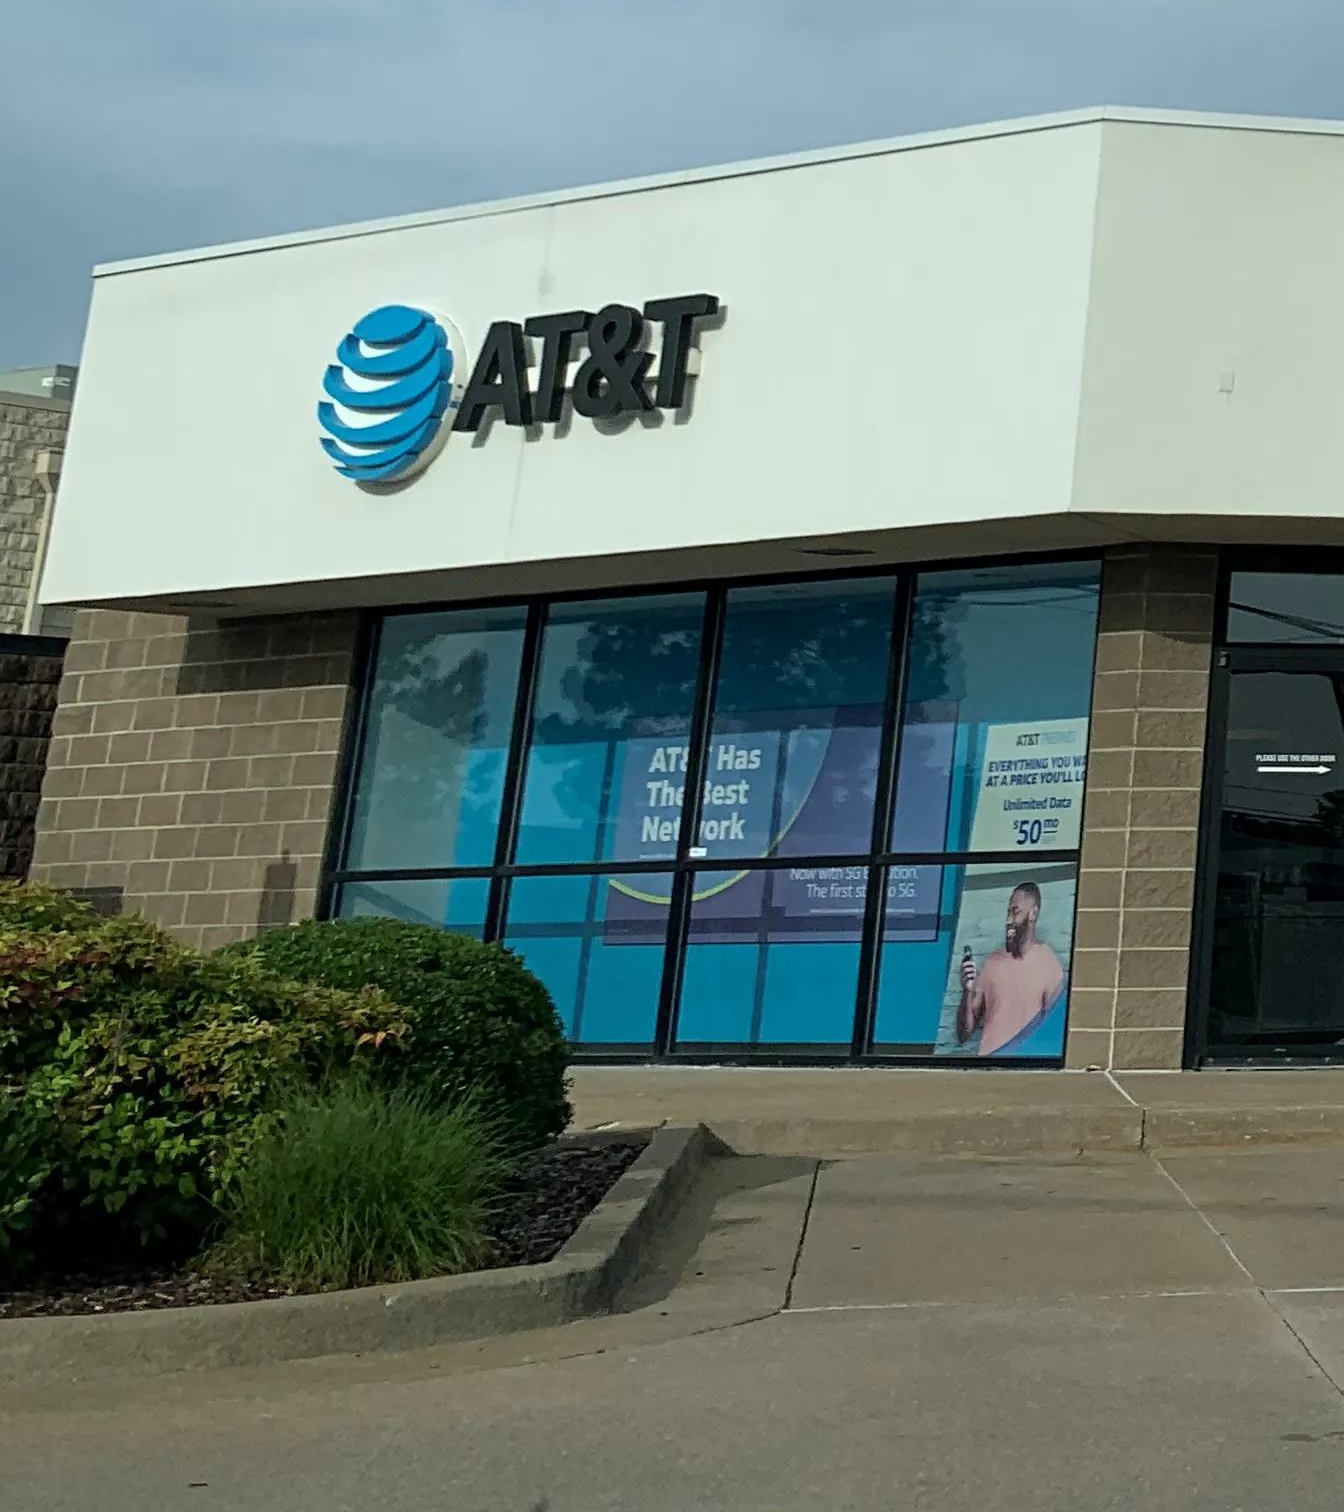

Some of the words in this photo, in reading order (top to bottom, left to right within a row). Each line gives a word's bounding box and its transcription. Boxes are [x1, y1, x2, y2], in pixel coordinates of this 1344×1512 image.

[452, 293, 719, 433] AT&T
[1015, 733, 1041, 746] AT&T
[648, 746, 712, 773] AT&
[717, 744, 761, 770] Has
[987, 757, 1049, 773] EVERYTHING
[1051, 755, 1071, 768] YOU
[985, 775, 998, 787] AT
[999, 775, 1008, 786] A
[1010, 772, 1039, 786] PRICE
[1040, 771, 1073, 784] YOU'LL
[646, 779, 685, 807] The
[1003, 797, 1048, 812] Unlimited
[1049, 796, 1072, 809] Data
[641, 811, 745, 842] Netork
[806, 883, 828, 899] The
[828, 882, 853, 898] first
